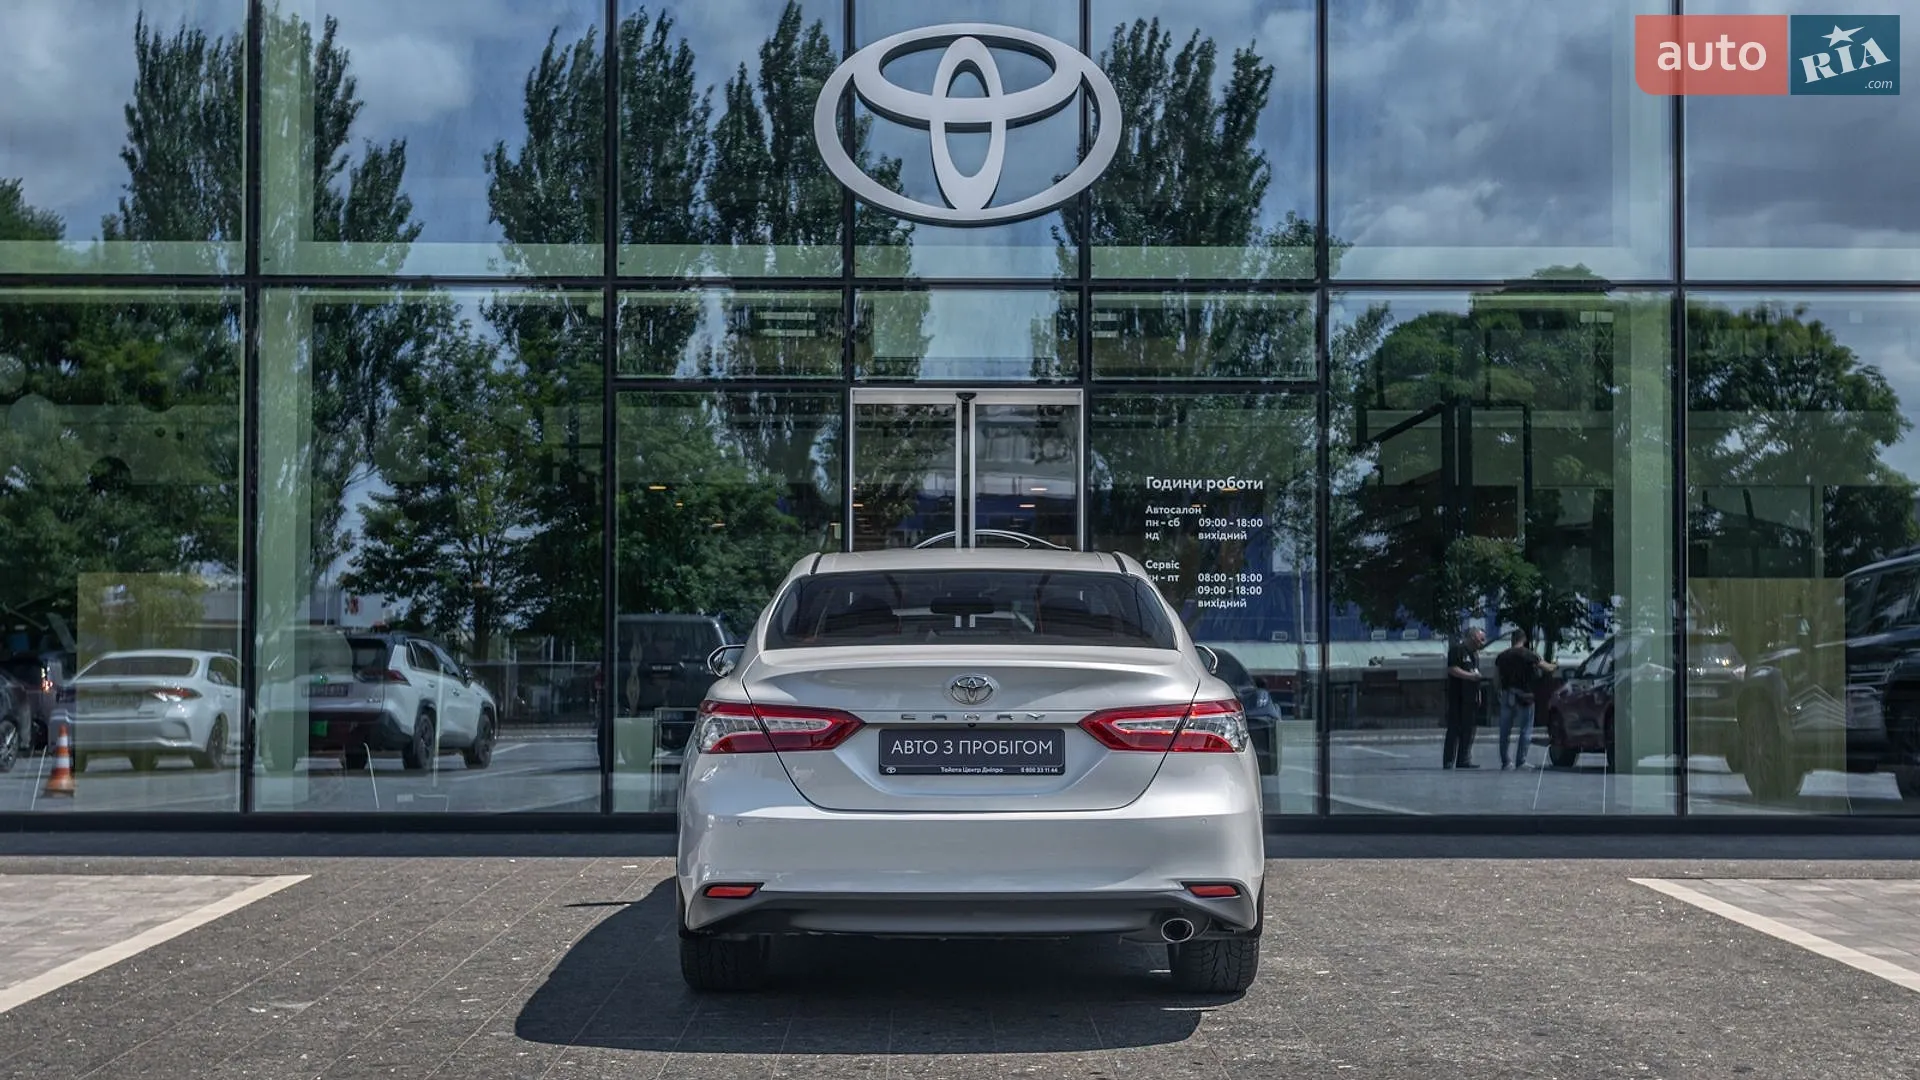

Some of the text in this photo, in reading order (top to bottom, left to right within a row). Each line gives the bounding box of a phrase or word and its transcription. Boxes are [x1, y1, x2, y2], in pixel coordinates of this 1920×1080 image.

[1145, 476, 1264, 491] Години роботи
[1145, 505, 1202, 515] Автосалон
[1198, 518, 1228, 528] 09:00
[1236, 518, 1264, 528] 18:00
[1145, 531, 1248, 541] нд вихідний
[1145, 560, 1180, 571] Сервіс
[1197, 573, 1227, 583] 08:00
[1235, 573, 1263, 583] 18:00
[1197, 585, 1227, 596] 09:00
[1235, 585, 1263, 596] 18:00
[1197, 597, 1247, 608] вихідний
[900, 713, 1046, 721] CAMRY
[891, 740, 938, 755] АВТО
[959, 740, 1053, 755] ПРОБІГОМ
